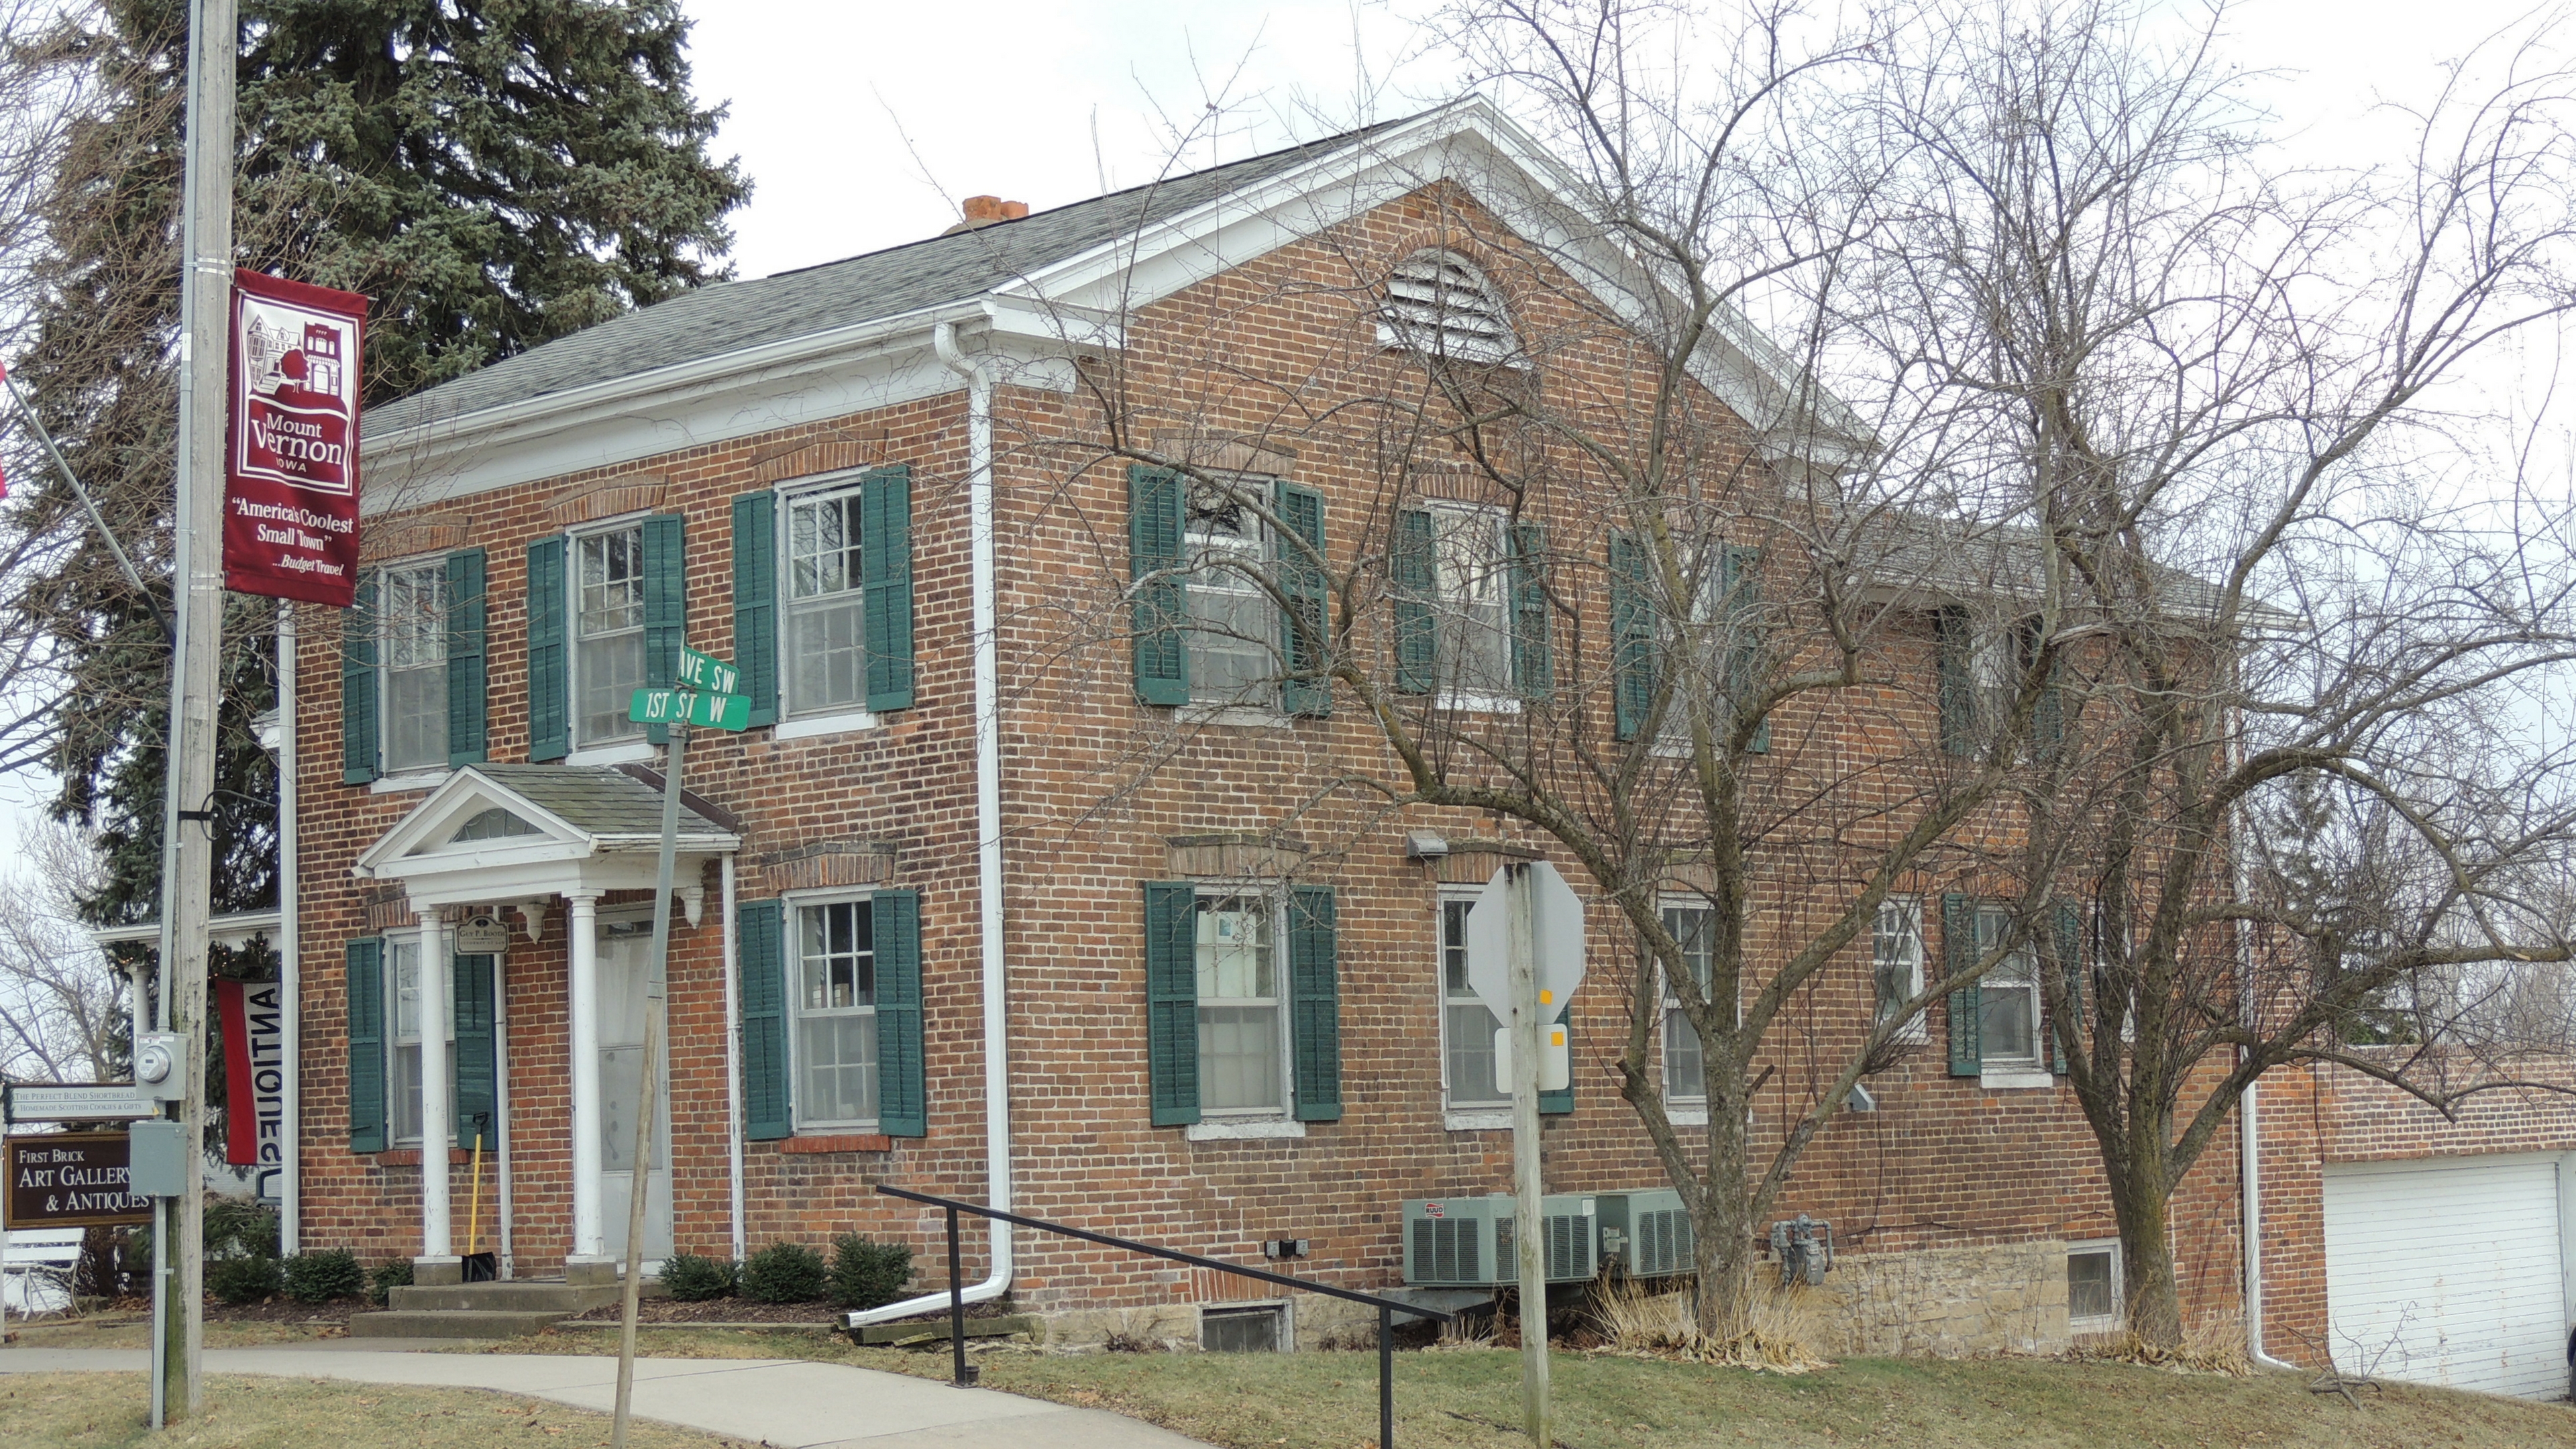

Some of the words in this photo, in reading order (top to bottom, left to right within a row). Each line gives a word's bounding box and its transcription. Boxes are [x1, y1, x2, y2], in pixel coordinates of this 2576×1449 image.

[267, 413, 322, 437] Mount
[251, 419, 342, 465] Vernon
[276, 457, 307, 473] IOWA
[300, 508, 354, 534] Coolest
[257, 523, 295, 545] Small
[297, 529, 333, 551] Town”
[315, 559, 345, 576] Travel
[711, 665, 735, 694] SW
[645, 692, 669, 718] 1ST
[676, 693, 698, 719] ST
[709, 696, 727, 722] W
[32, 1092, 62, 1100] PERFECT
[64, 1091, 88, 1099] BLEND
[89, 1091, 136, 1099] SHORTBREAD
[19, 1150, 49, 1164] FIRST
[52, 1148, 85, 1163] BRICK
[19, 1167, 55, 1188] ART
[46, 1194, 59, 1212] &
[65, 1190, 150, 1213] ANTIQUES
